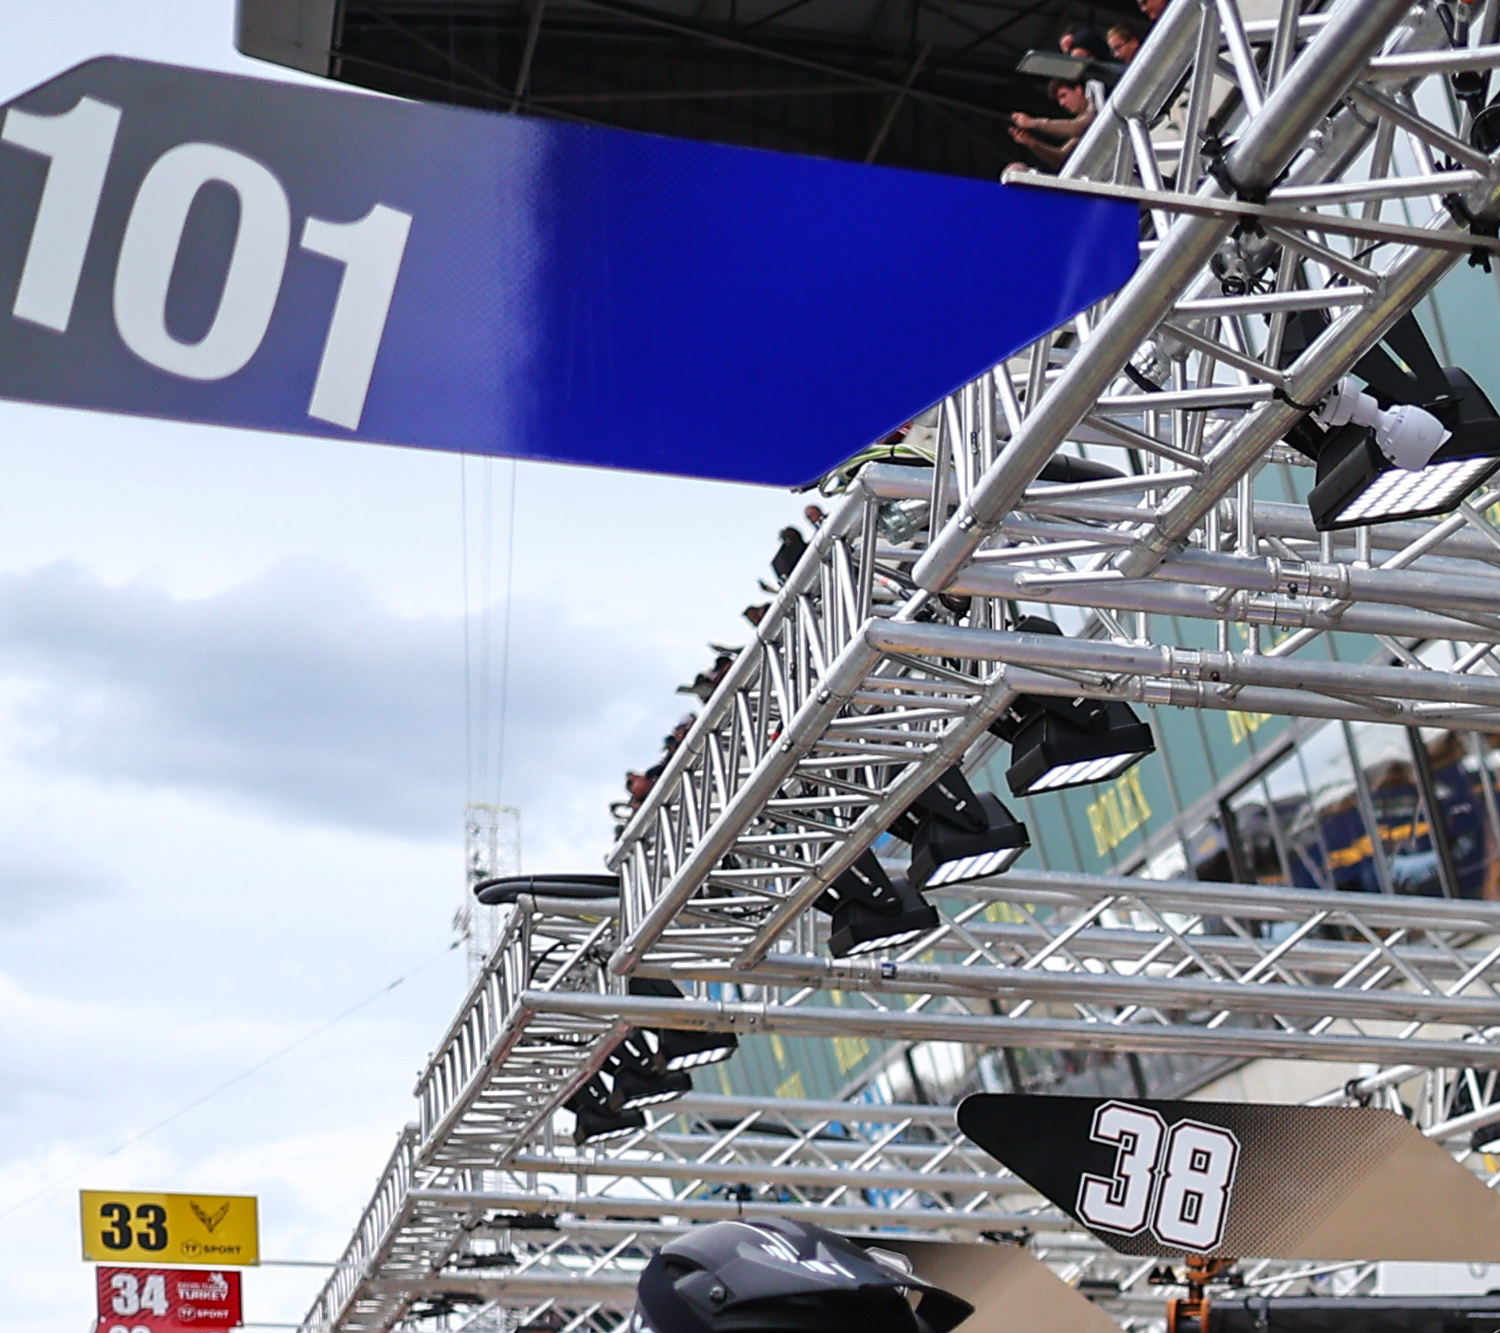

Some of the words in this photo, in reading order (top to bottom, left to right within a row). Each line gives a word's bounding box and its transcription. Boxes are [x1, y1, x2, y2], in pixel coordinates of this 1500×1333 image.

[2, 94, 413, 431] 101
[1076, 1101, 1240, 1251] 38
[100, 1202, 168, 1252] 33
[111, 1272, 170, 1316] 34
[178, 1289, 227, 1301] TURKEY
